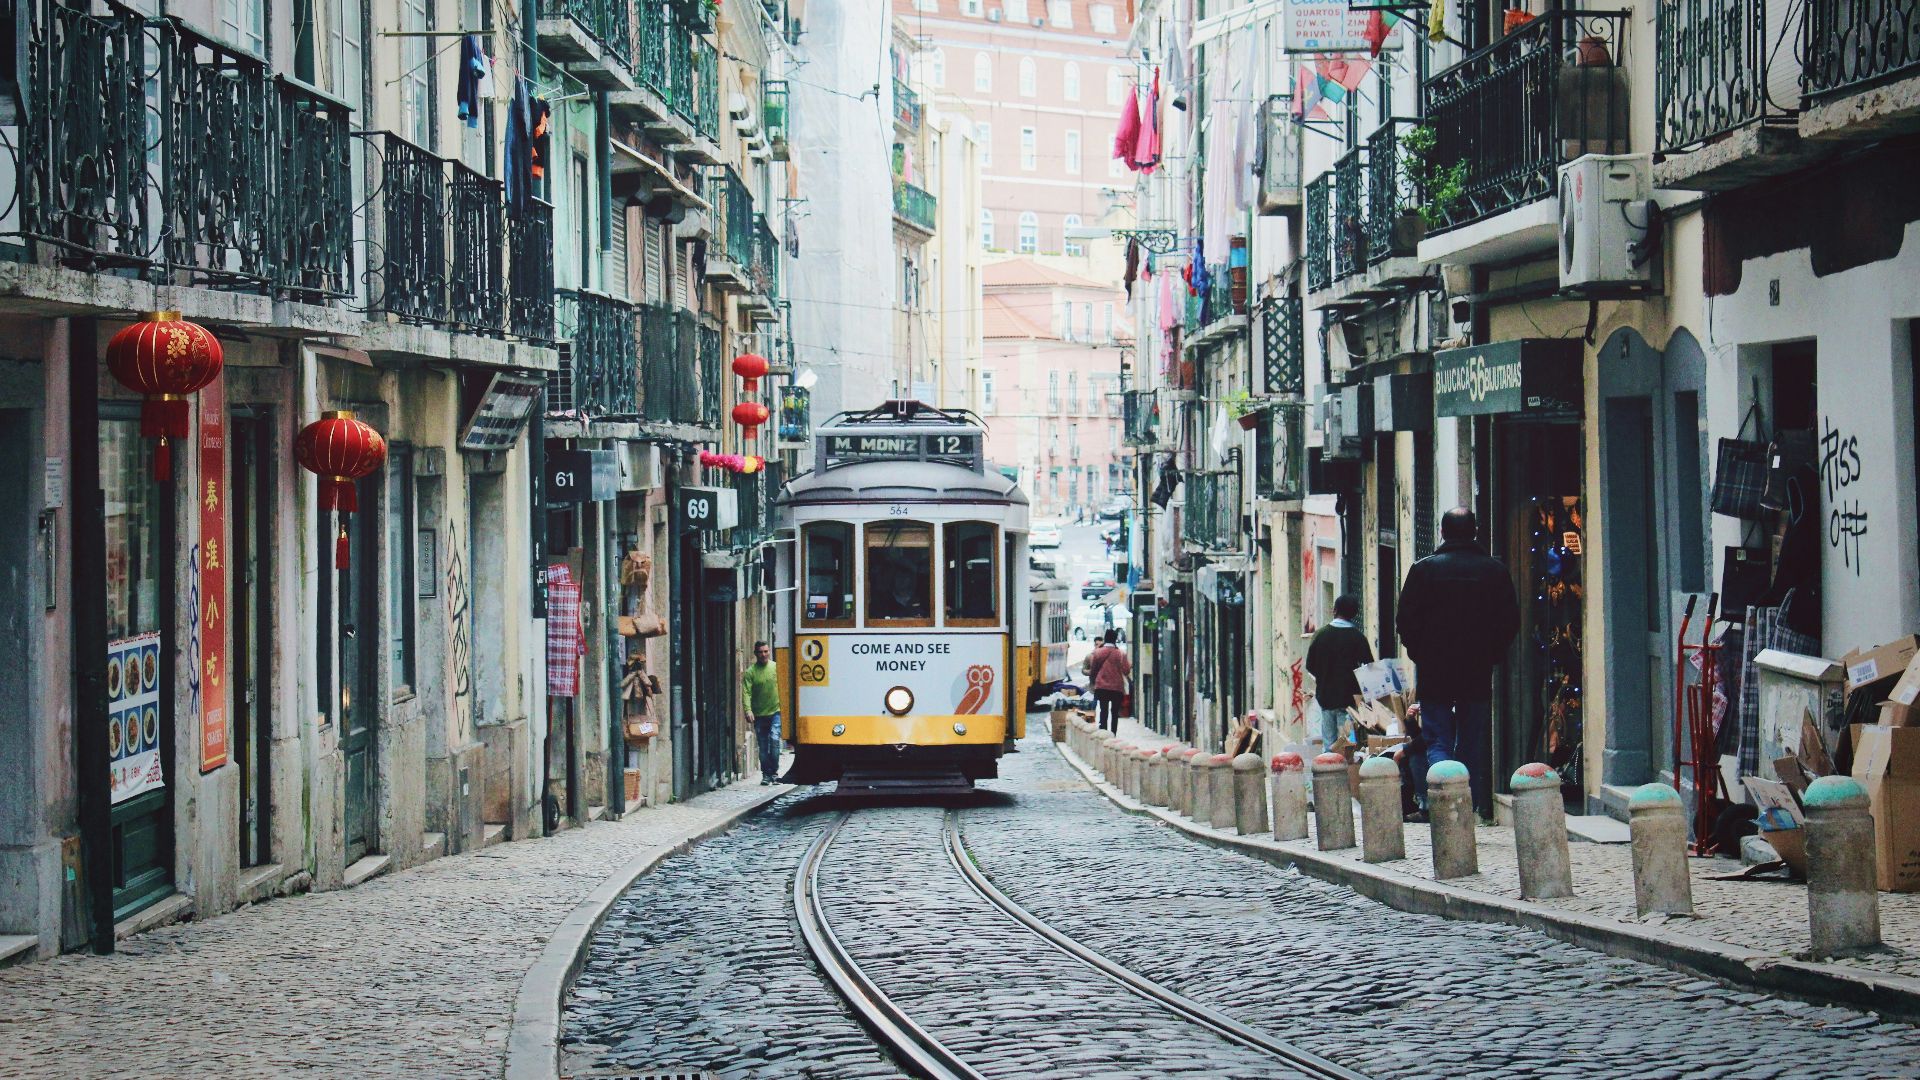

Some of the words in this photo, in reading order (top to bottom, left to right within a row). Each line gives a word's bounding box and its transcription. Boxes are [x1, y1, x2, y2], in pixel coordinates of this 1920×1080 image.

[1295, 9, 1341, 17] QUARTOS
[1469, 355, 1486, 402] 56
[834, 437, 852, 450] M.
[860, 437, 918, 451] MONIZ
[937, 436, 960, 454] 12
[555, 472, 574, 487] 61
[687, 498, 708, 519] 69
[890, 506, 908, 516] 564
[851, 643, 891, 655] COME
[894, 643, 924, 655] AND
[927, 643, 951, 655] SEE
[875, 660, 926, 672] MONEY
